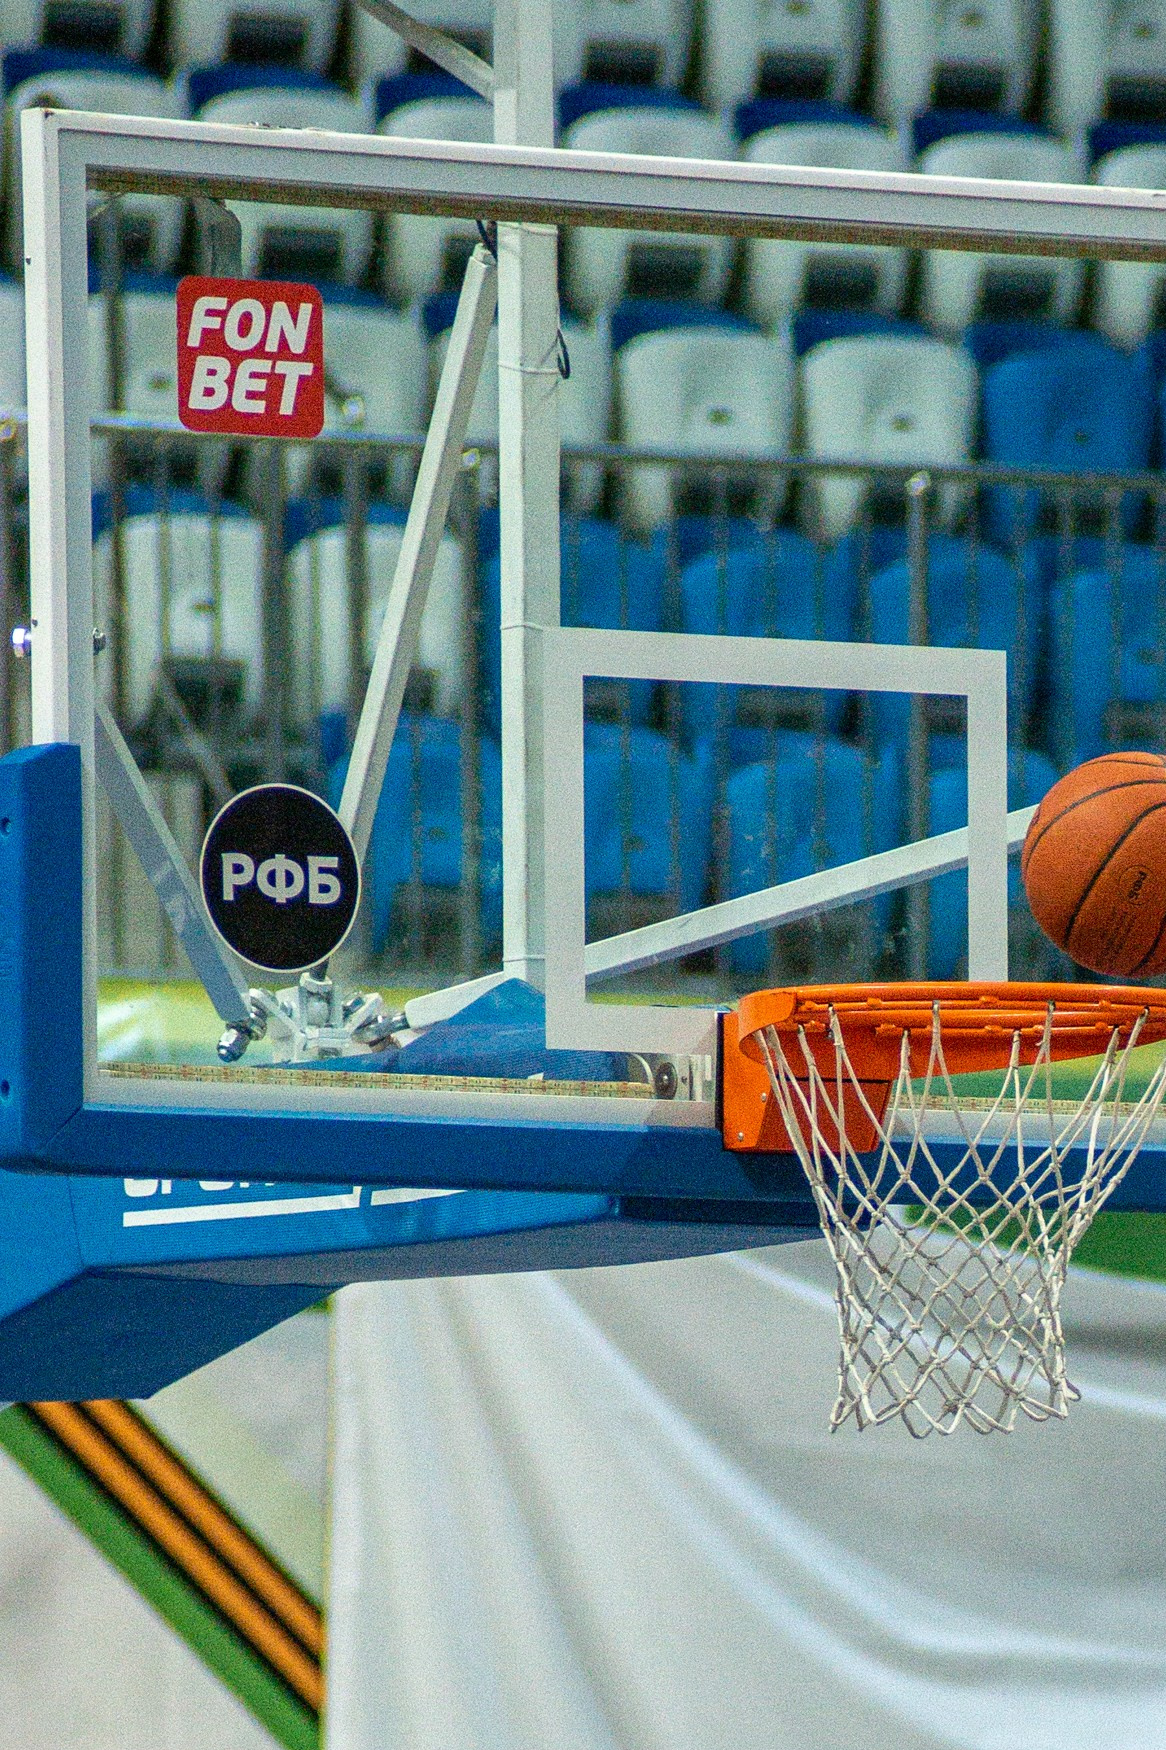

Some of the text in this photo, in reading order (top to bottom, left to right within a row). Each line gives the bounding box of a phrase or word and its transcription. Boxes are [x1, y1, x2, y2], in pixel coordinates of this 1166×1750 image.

[187, 296, 313, 354] FON
[188, 355, 314, 415] BET
[221, 852, 341, 904] РФБ
